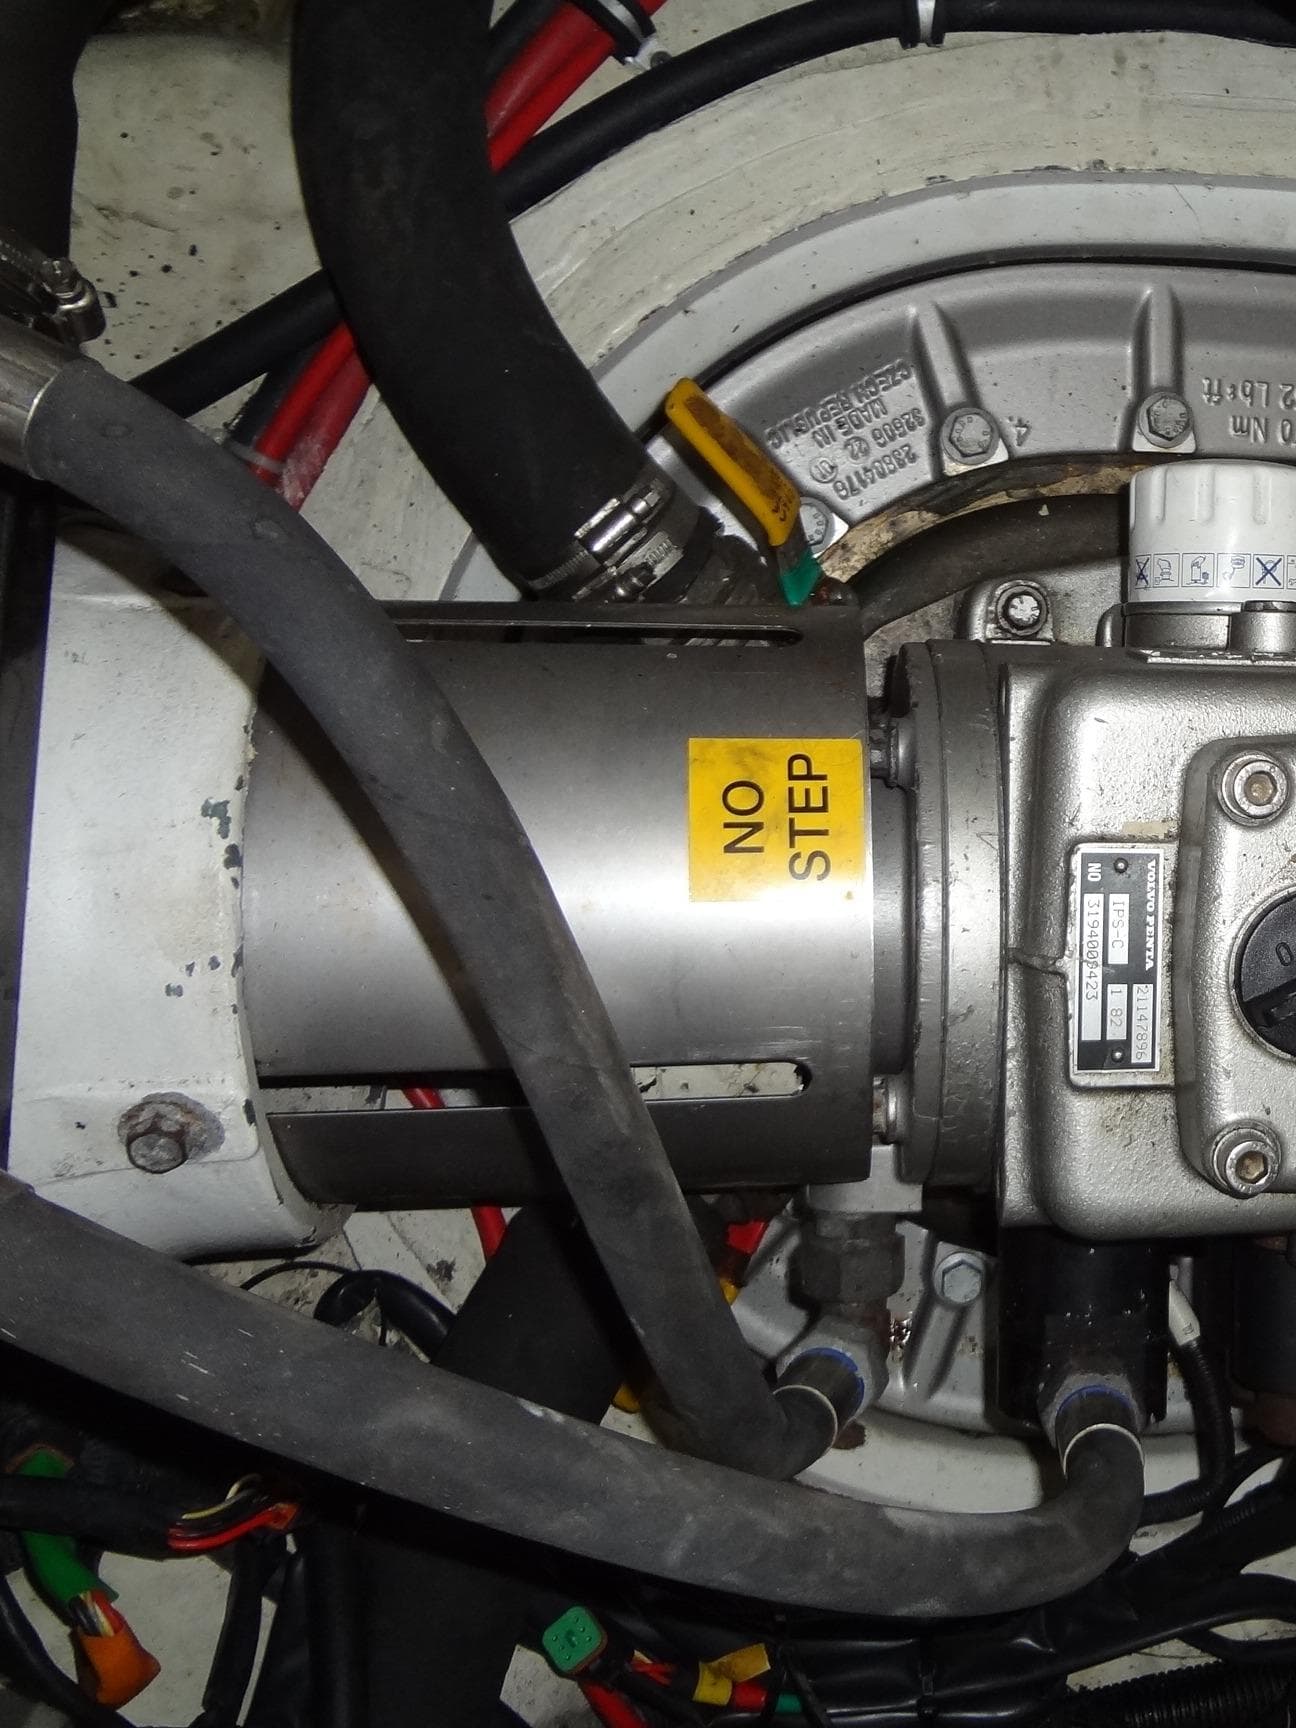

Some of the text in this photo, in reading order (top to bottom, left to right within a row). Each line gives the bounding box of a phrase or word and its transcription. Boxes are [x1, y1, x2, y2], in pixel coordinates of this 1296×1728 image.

[812, 398, 888, 449] MADE IN
[1229, 415, 1268, 443] Nm
[721, 780, 765, 854] NO
[788, 753, 832, 881] STEP
[1087, 862, 1102, 882] NO
[1111, 899, 1124, 949] IPS-C
[1145, 858, 1156, 971] VOLVO PENTA
[1110, 1008, 1123, 1027] 82
[1135, 985, 1149, 1061] 21147896
